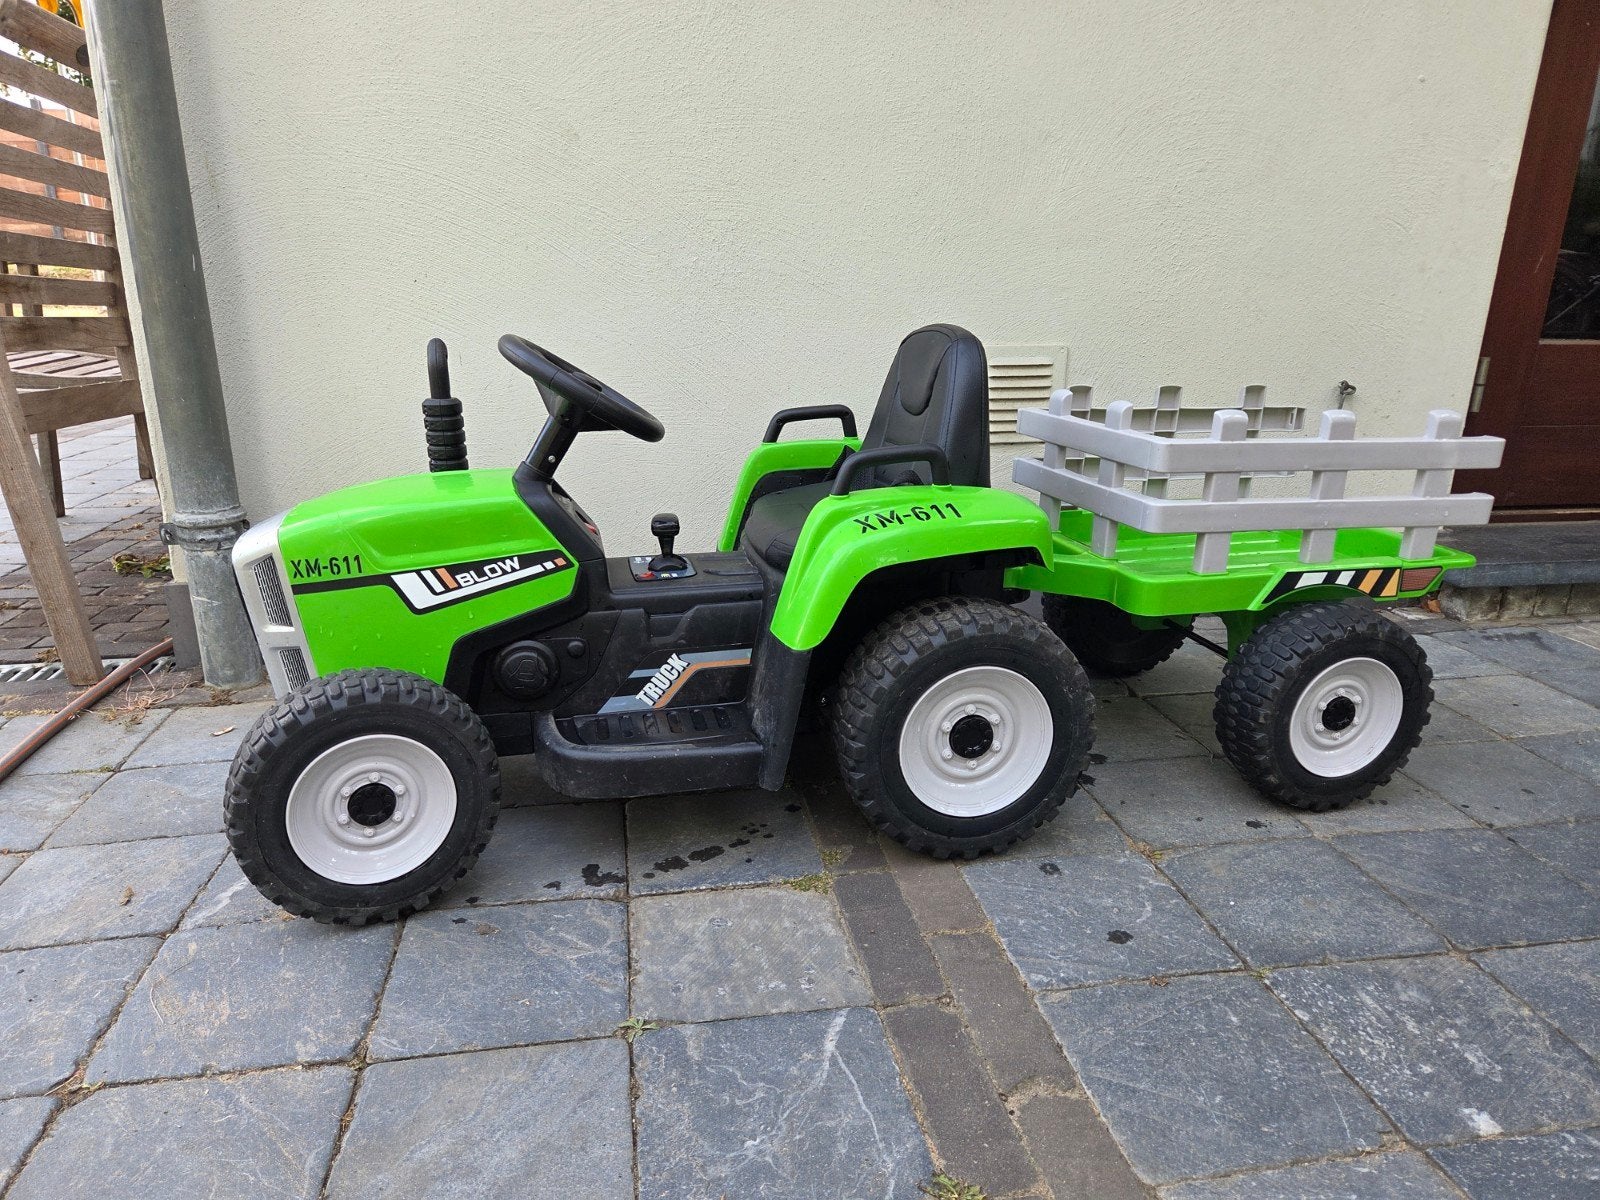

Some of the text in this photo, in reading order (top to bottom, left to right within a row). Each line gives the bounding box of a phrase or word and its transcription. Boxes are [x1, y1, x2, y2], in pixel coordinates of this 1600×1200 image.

[854, 503, 962, 533] XM-611
[290, 555, 362, 578] XM-611
[455, 556, 520, 587] BLOW
[635, 653, 690, 706] TRUCK
